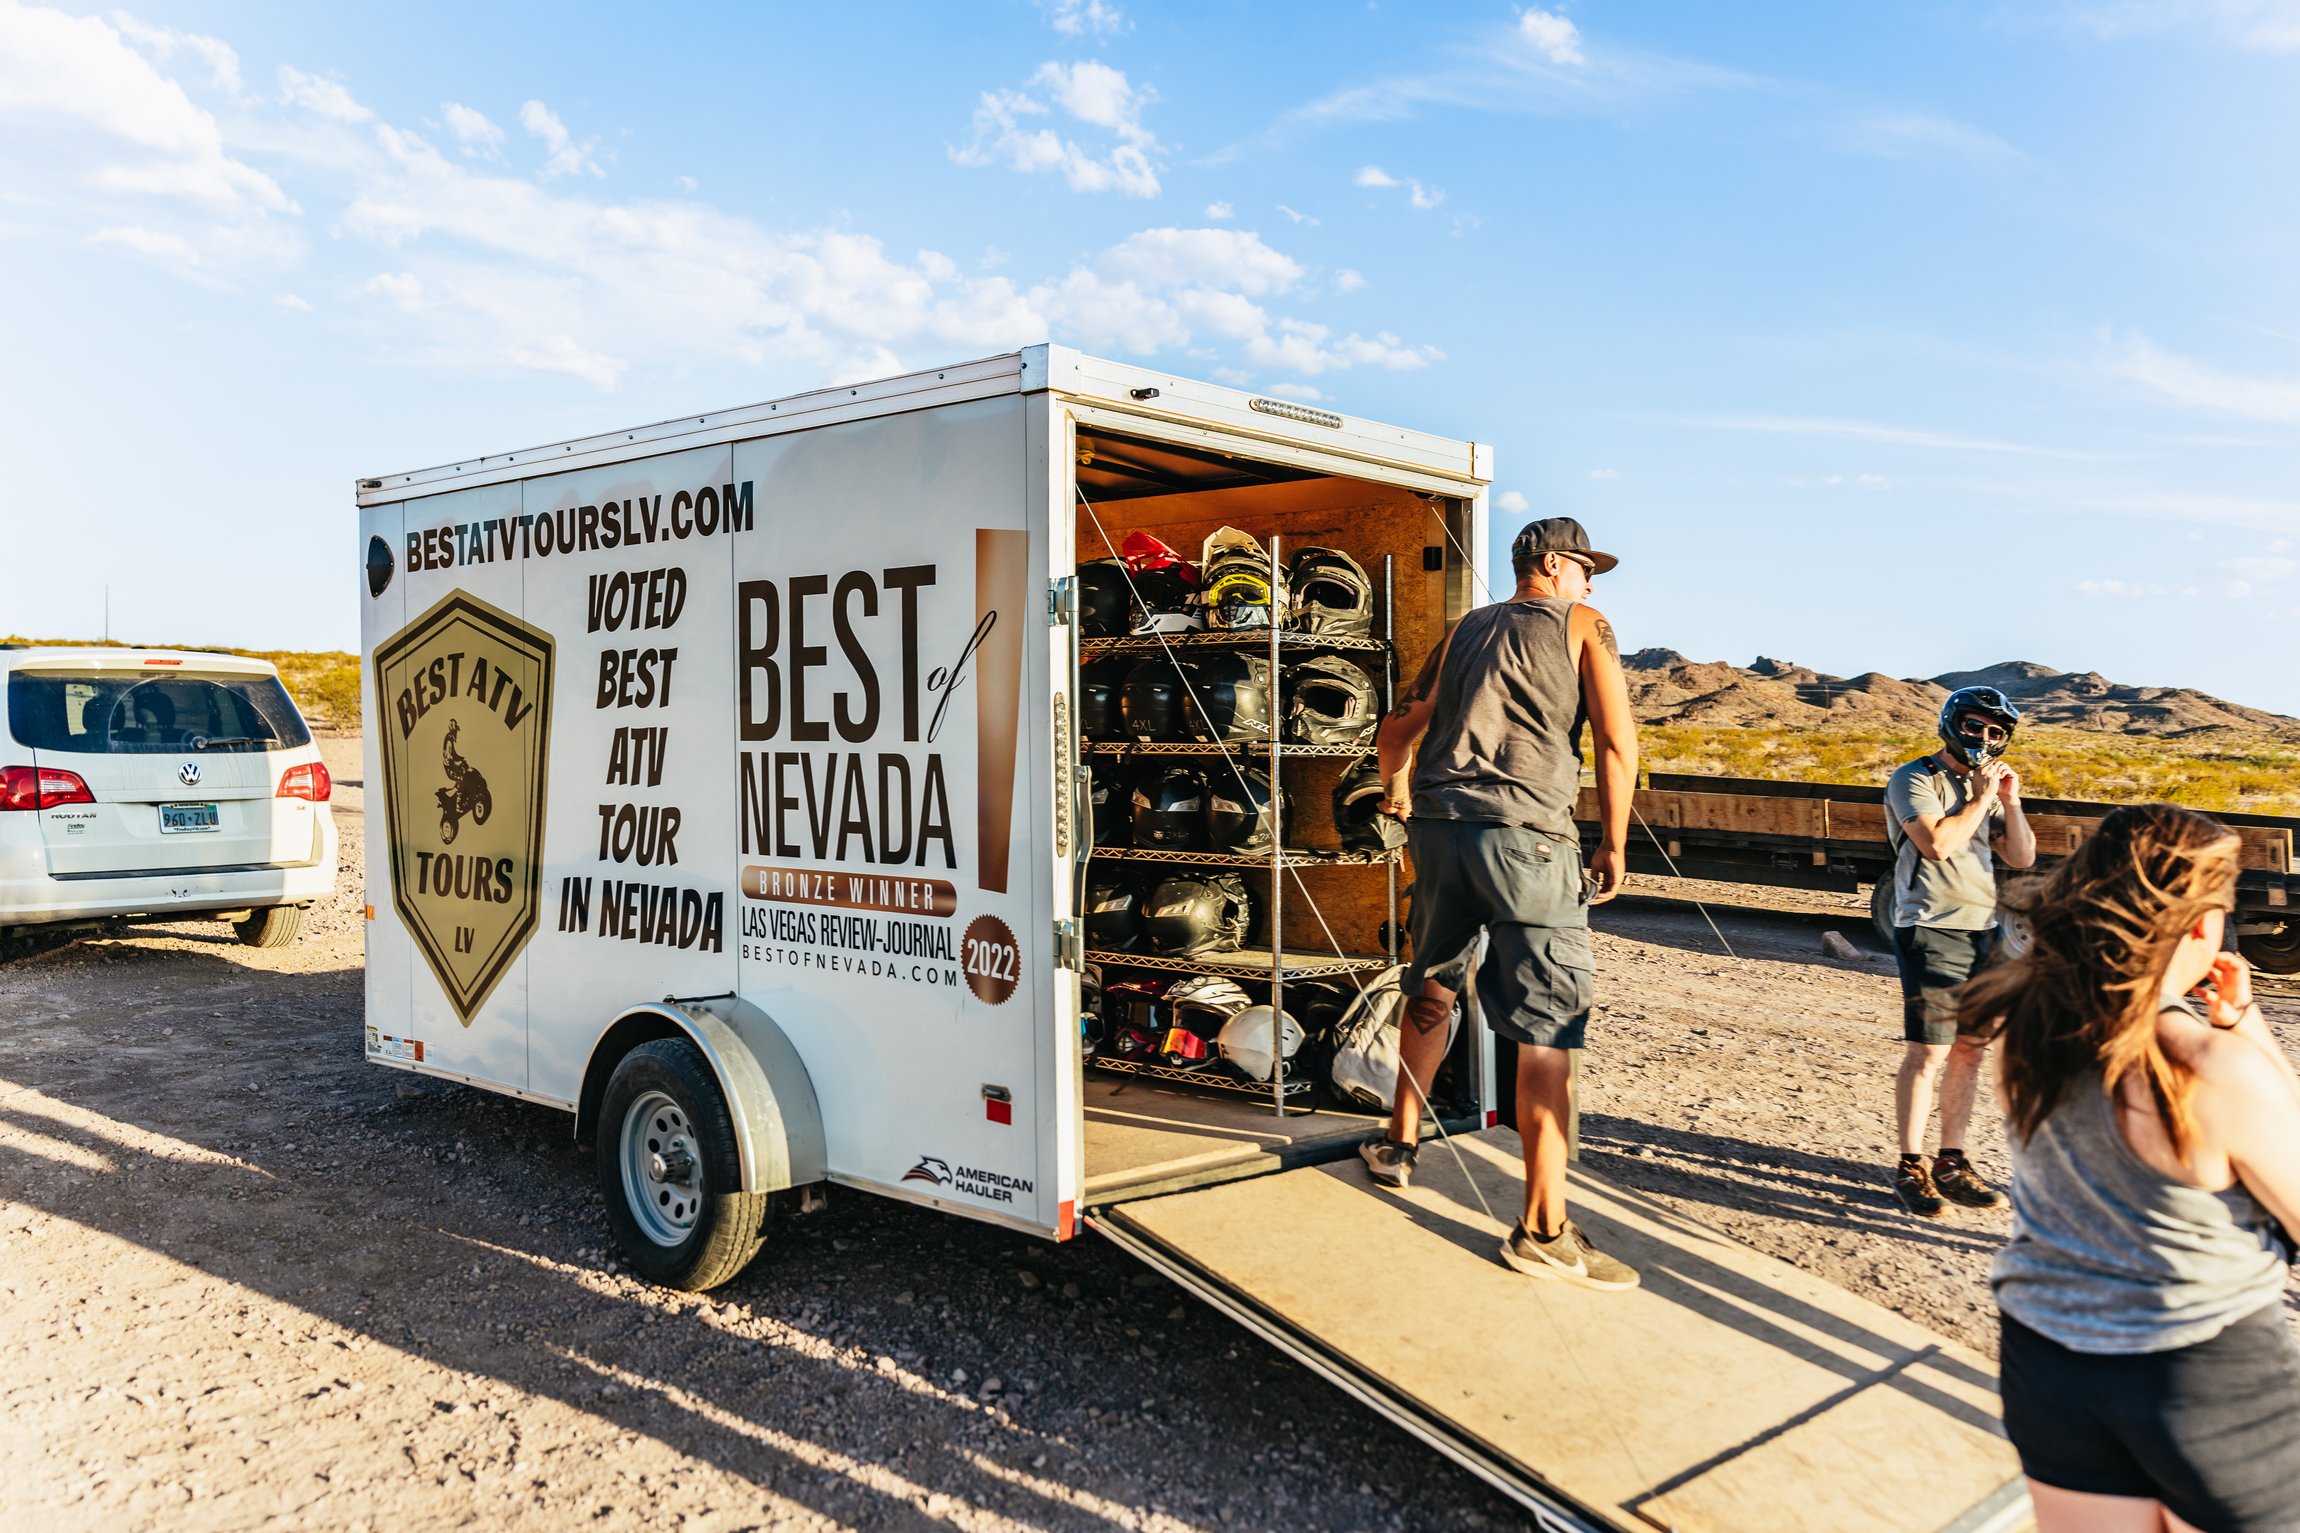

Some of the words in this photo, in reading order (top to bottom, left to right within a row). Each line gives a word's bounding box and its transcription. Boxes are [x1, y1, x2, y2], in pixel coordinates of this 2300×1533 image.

[407, 480, 753, 572] BESTATVTOURSLV.COM
[587, 567, 687, 634] VOTED
[596, 647, 678, 710] BEST
[738, 563, 936, 743] BEST
[926, 610, 997, 743] of
[396, 652, 465, 740] BEST
[466, 656, 533, 731] ATV
[1132, 719, 1156, 732] 4XL
[606, 726, 668, 787] ATV
[598, 803, 681, 866] TOUR
[740, 752, 957, 869] NEVADA
[416, 851, 514, 904] TOURS
[759, 870, 835, 901] BRONZE
[849, 876, 934, 911] WINNER
[455, 926, 475, 954] LV
[558, 877, 592, 933] IN
[599, 880, 723, 953] NEVADA
[742, 905, 766, 939] LAS
[769, 909, 816, 944] VEGAS
[821, 914, 956, 961] REVIEW-JOURNAL
[742, 944, 957, 986] BESTOFNEVADA.COM
[967, 938, 1015, 982] 2022
[956, 1166, 1033, 1193] AMERICAN
[956, 1180, 1013, 1203] HAULER
